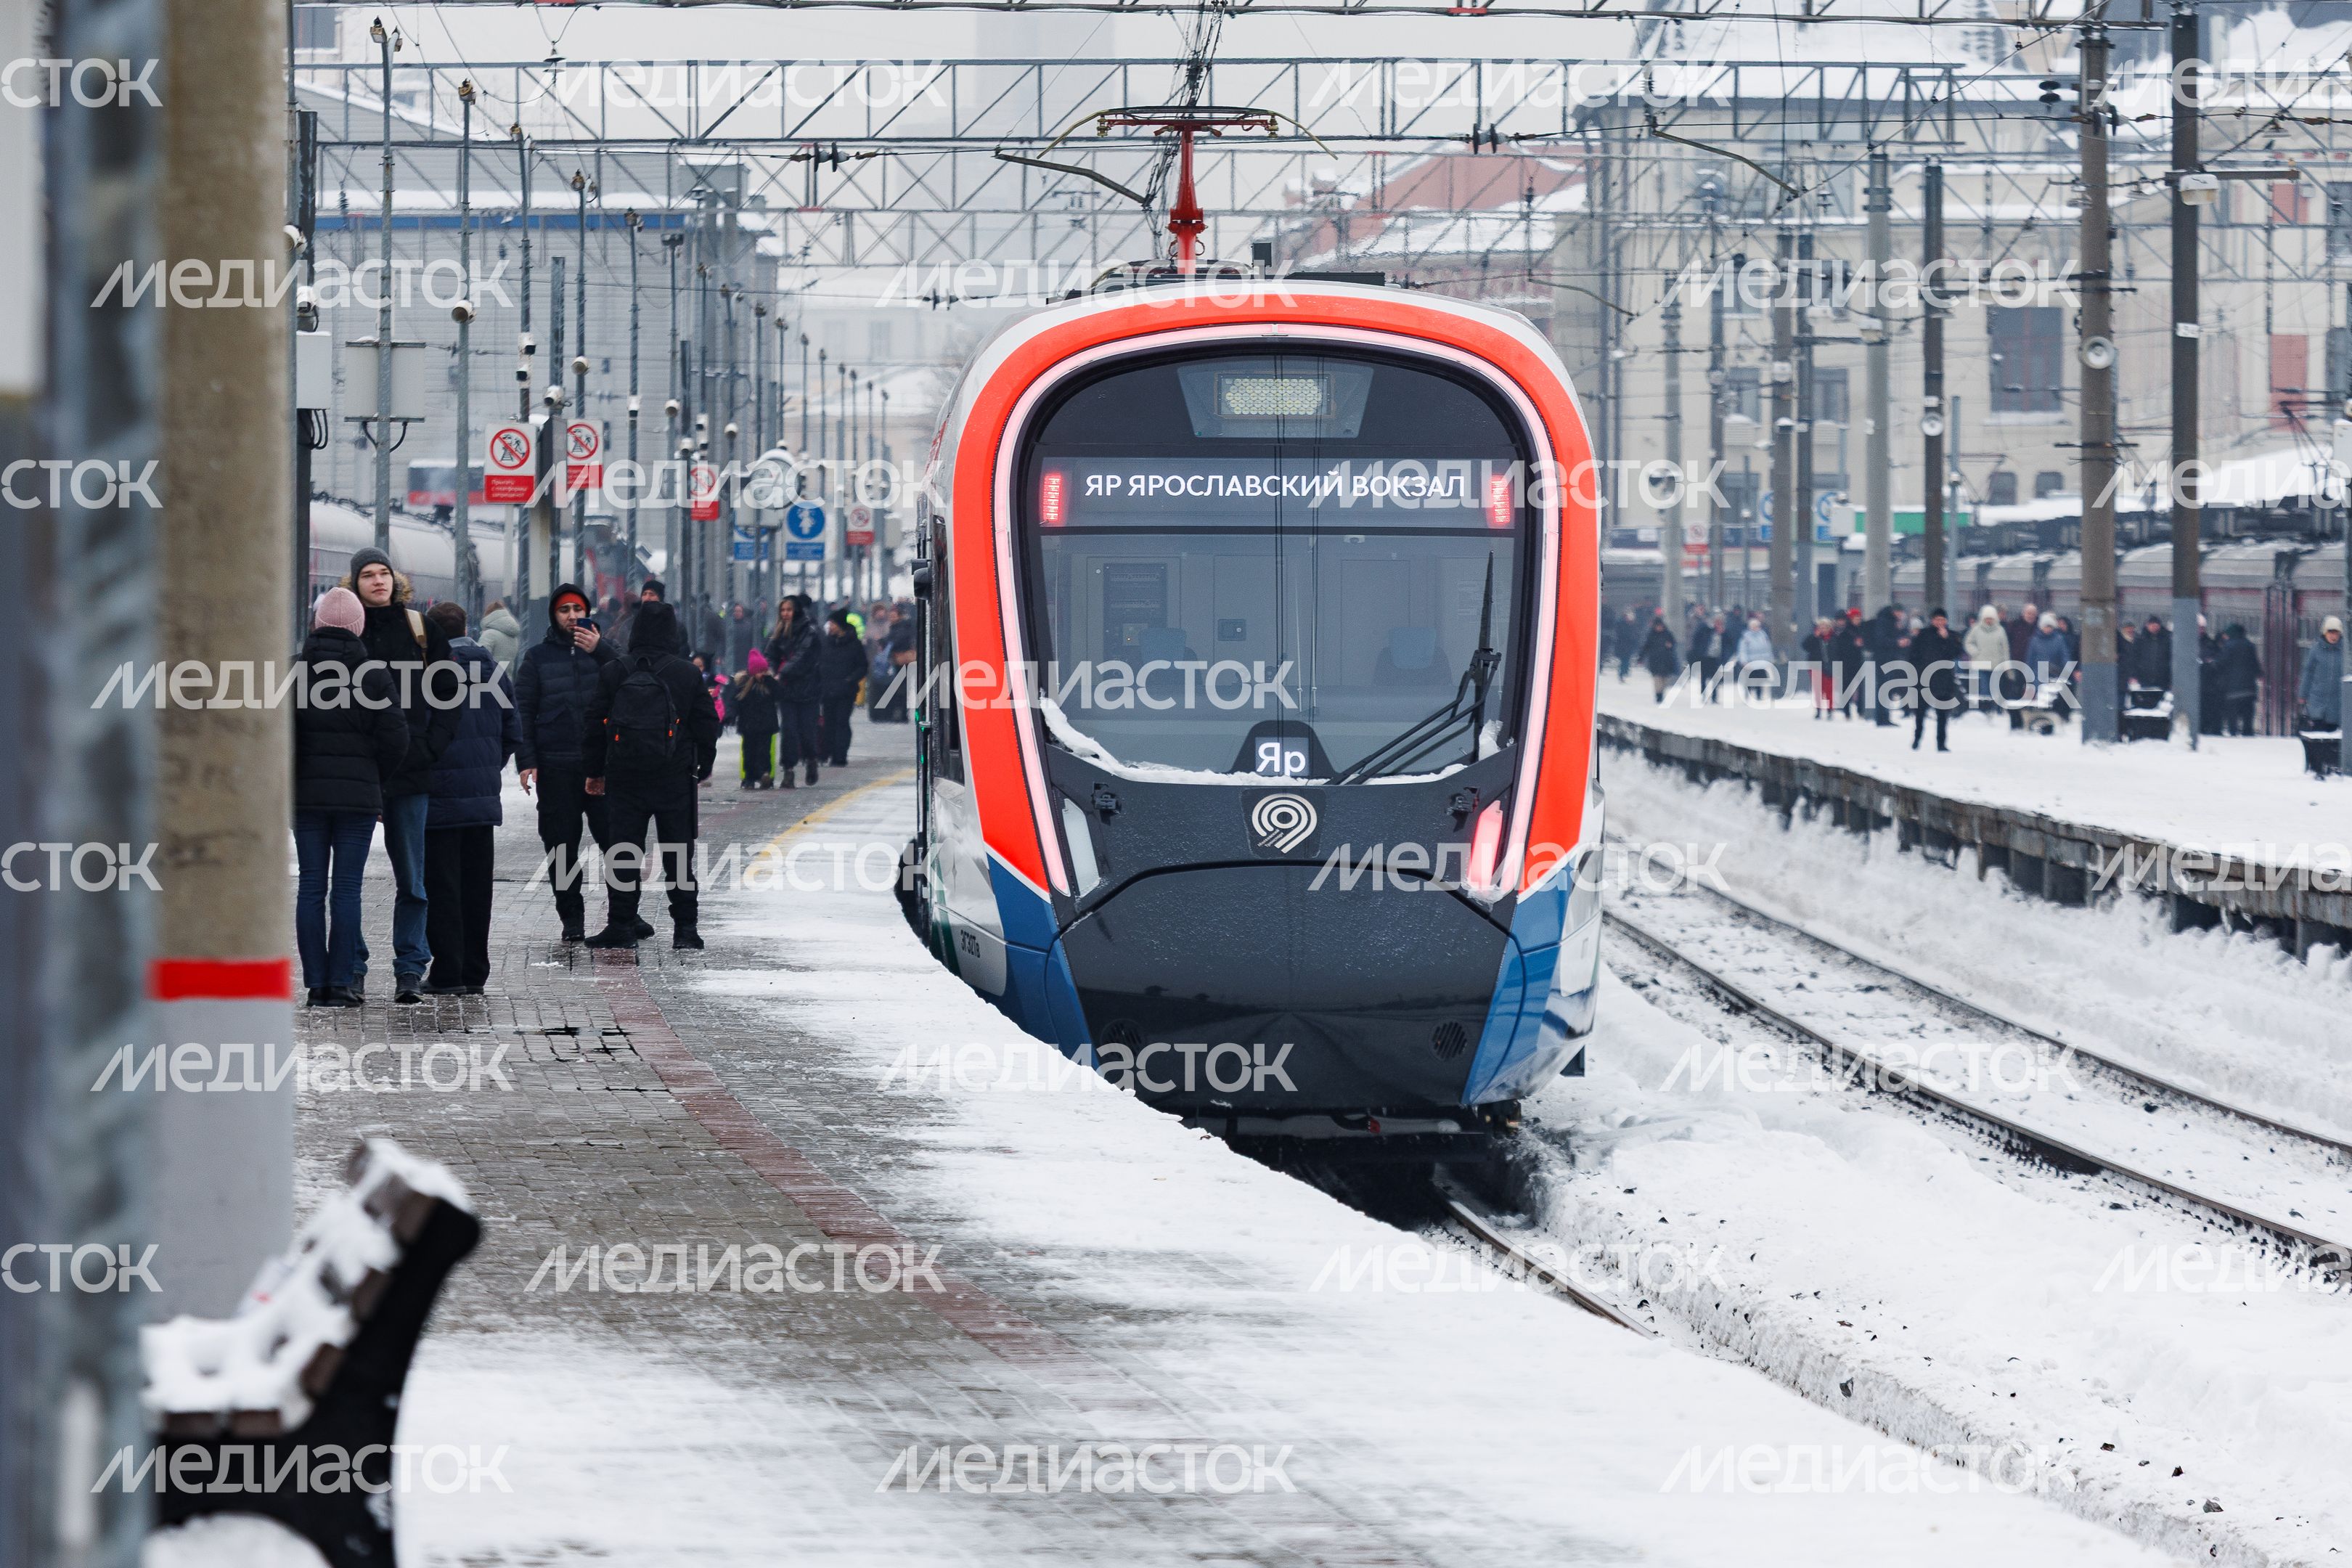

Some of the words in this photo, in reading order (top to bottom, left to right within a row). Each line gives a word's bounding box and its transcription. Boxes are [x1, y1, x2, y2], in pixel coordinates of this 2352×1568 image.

[1085, 475, 1122, 497] ЯР
[1127, 470, 1343, 497] ЯРОСЛАВСКИЙ
[1352, 475, 1465, 497] ВОКЗАЛ
[1256, 742, 1306, 776] Яр
